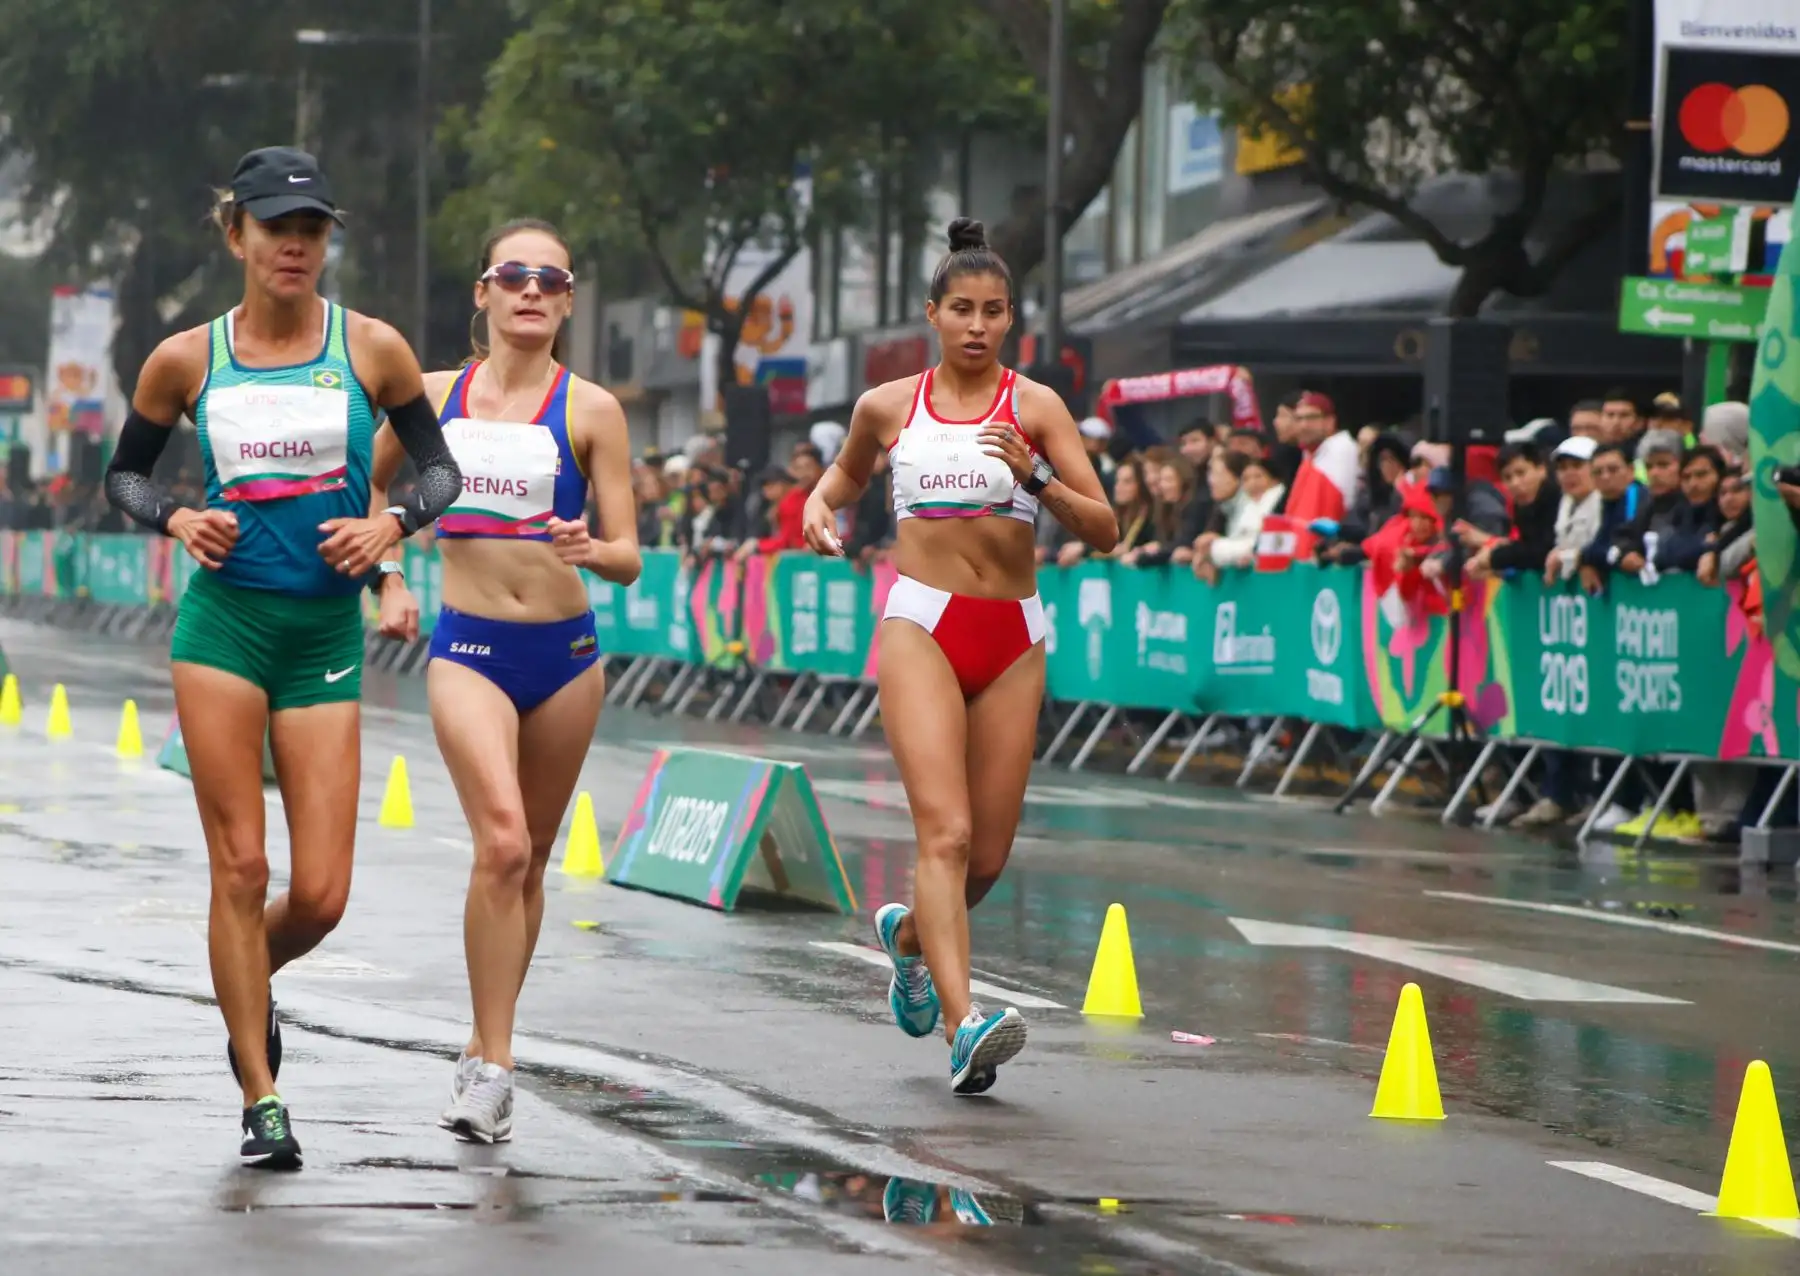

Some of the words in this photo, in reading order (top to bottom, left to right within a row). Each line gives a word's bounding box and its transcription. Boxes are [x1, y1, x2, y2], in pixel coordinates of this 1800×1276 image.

[1680, 20, 1797, 39] Bienvenidos
[1679, 156, 1782, 177] mastercard
[240, 440, 315, 460] ROCHA
[460, 476, 528, 497] RENAS
[919, 468, 988, 490] GARCÍA
[449, 641, 491, 656] SAETA
[1540, 651, 1589, 715] 2019
[1616, 659, 1683, 713] SPORTS
